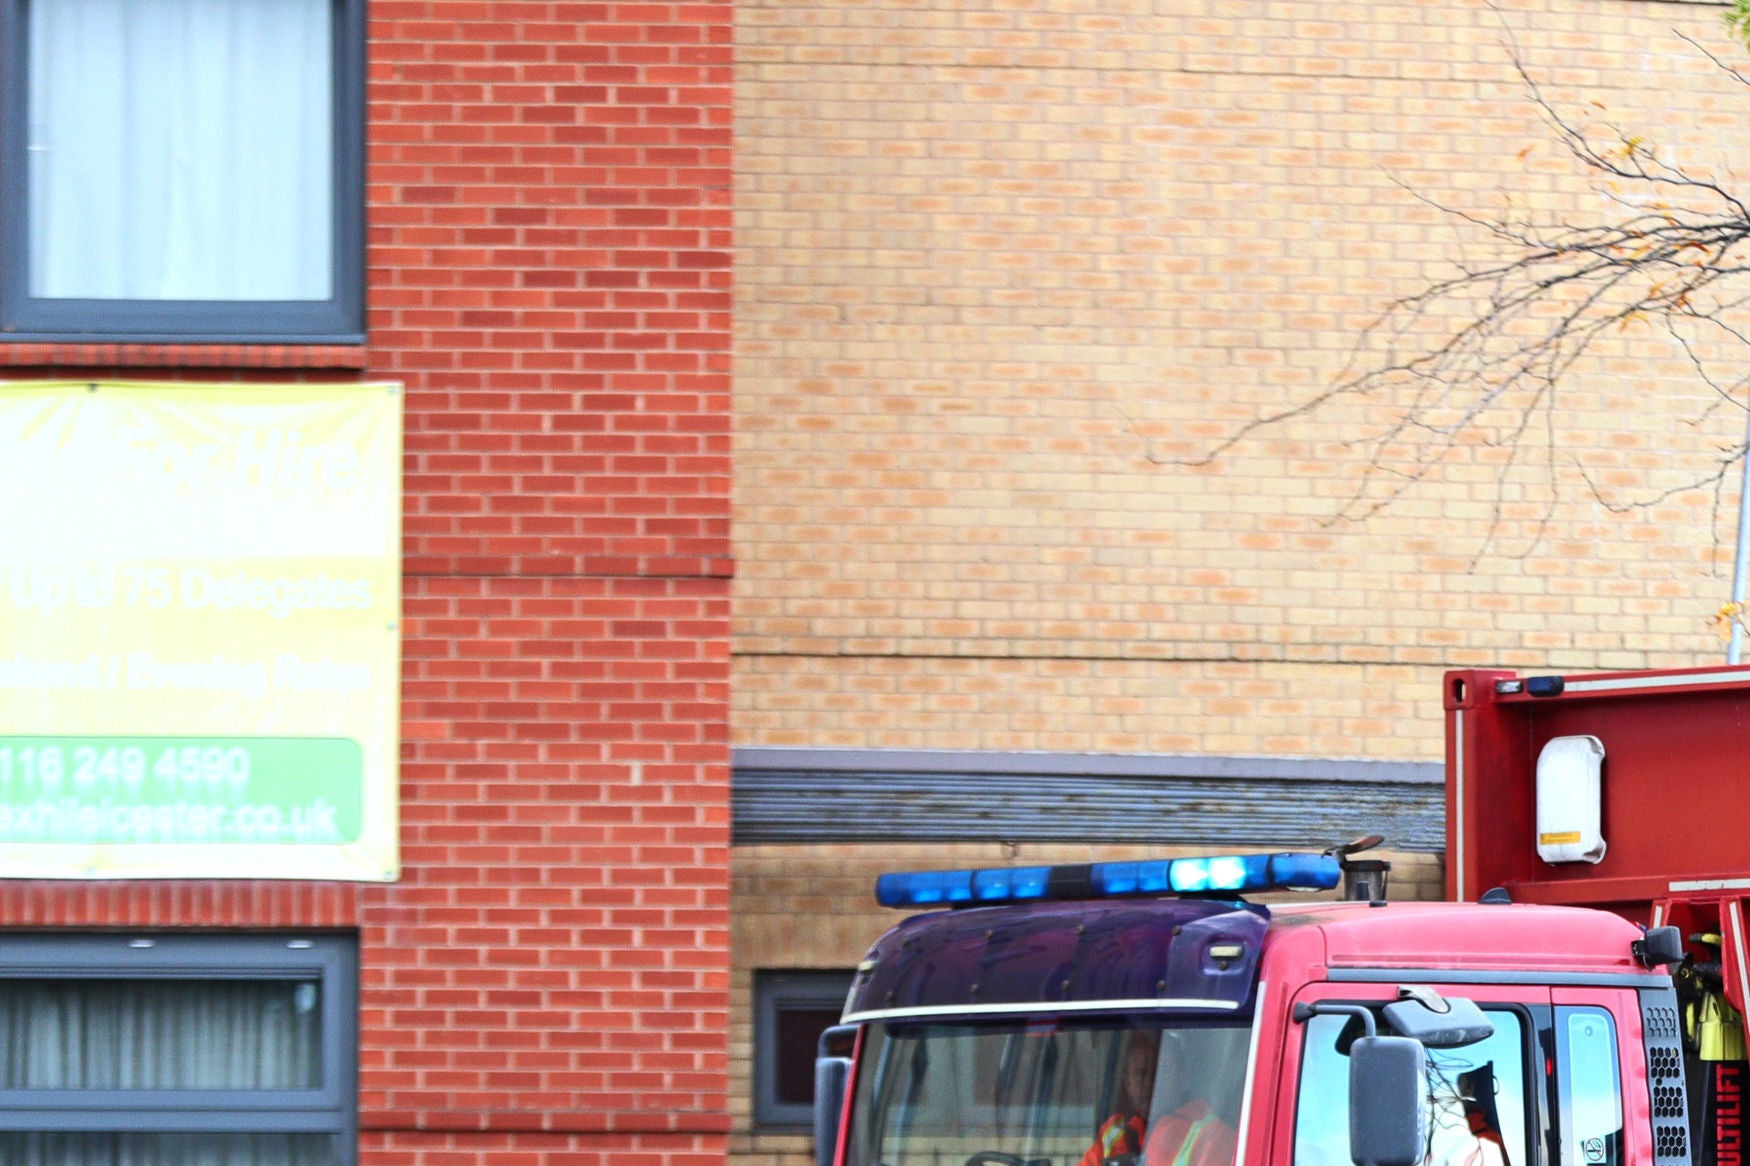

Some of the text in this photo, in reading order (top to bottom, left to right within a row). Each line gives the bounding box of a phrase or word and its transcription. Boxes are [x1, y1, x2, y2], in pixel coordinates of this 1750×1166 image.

[124, 569, 172, 608] 75
[181, 571, 374, 620] Delegates
[73, 746, 146, 784] 249
[155, 746, 250, 784] 4590
